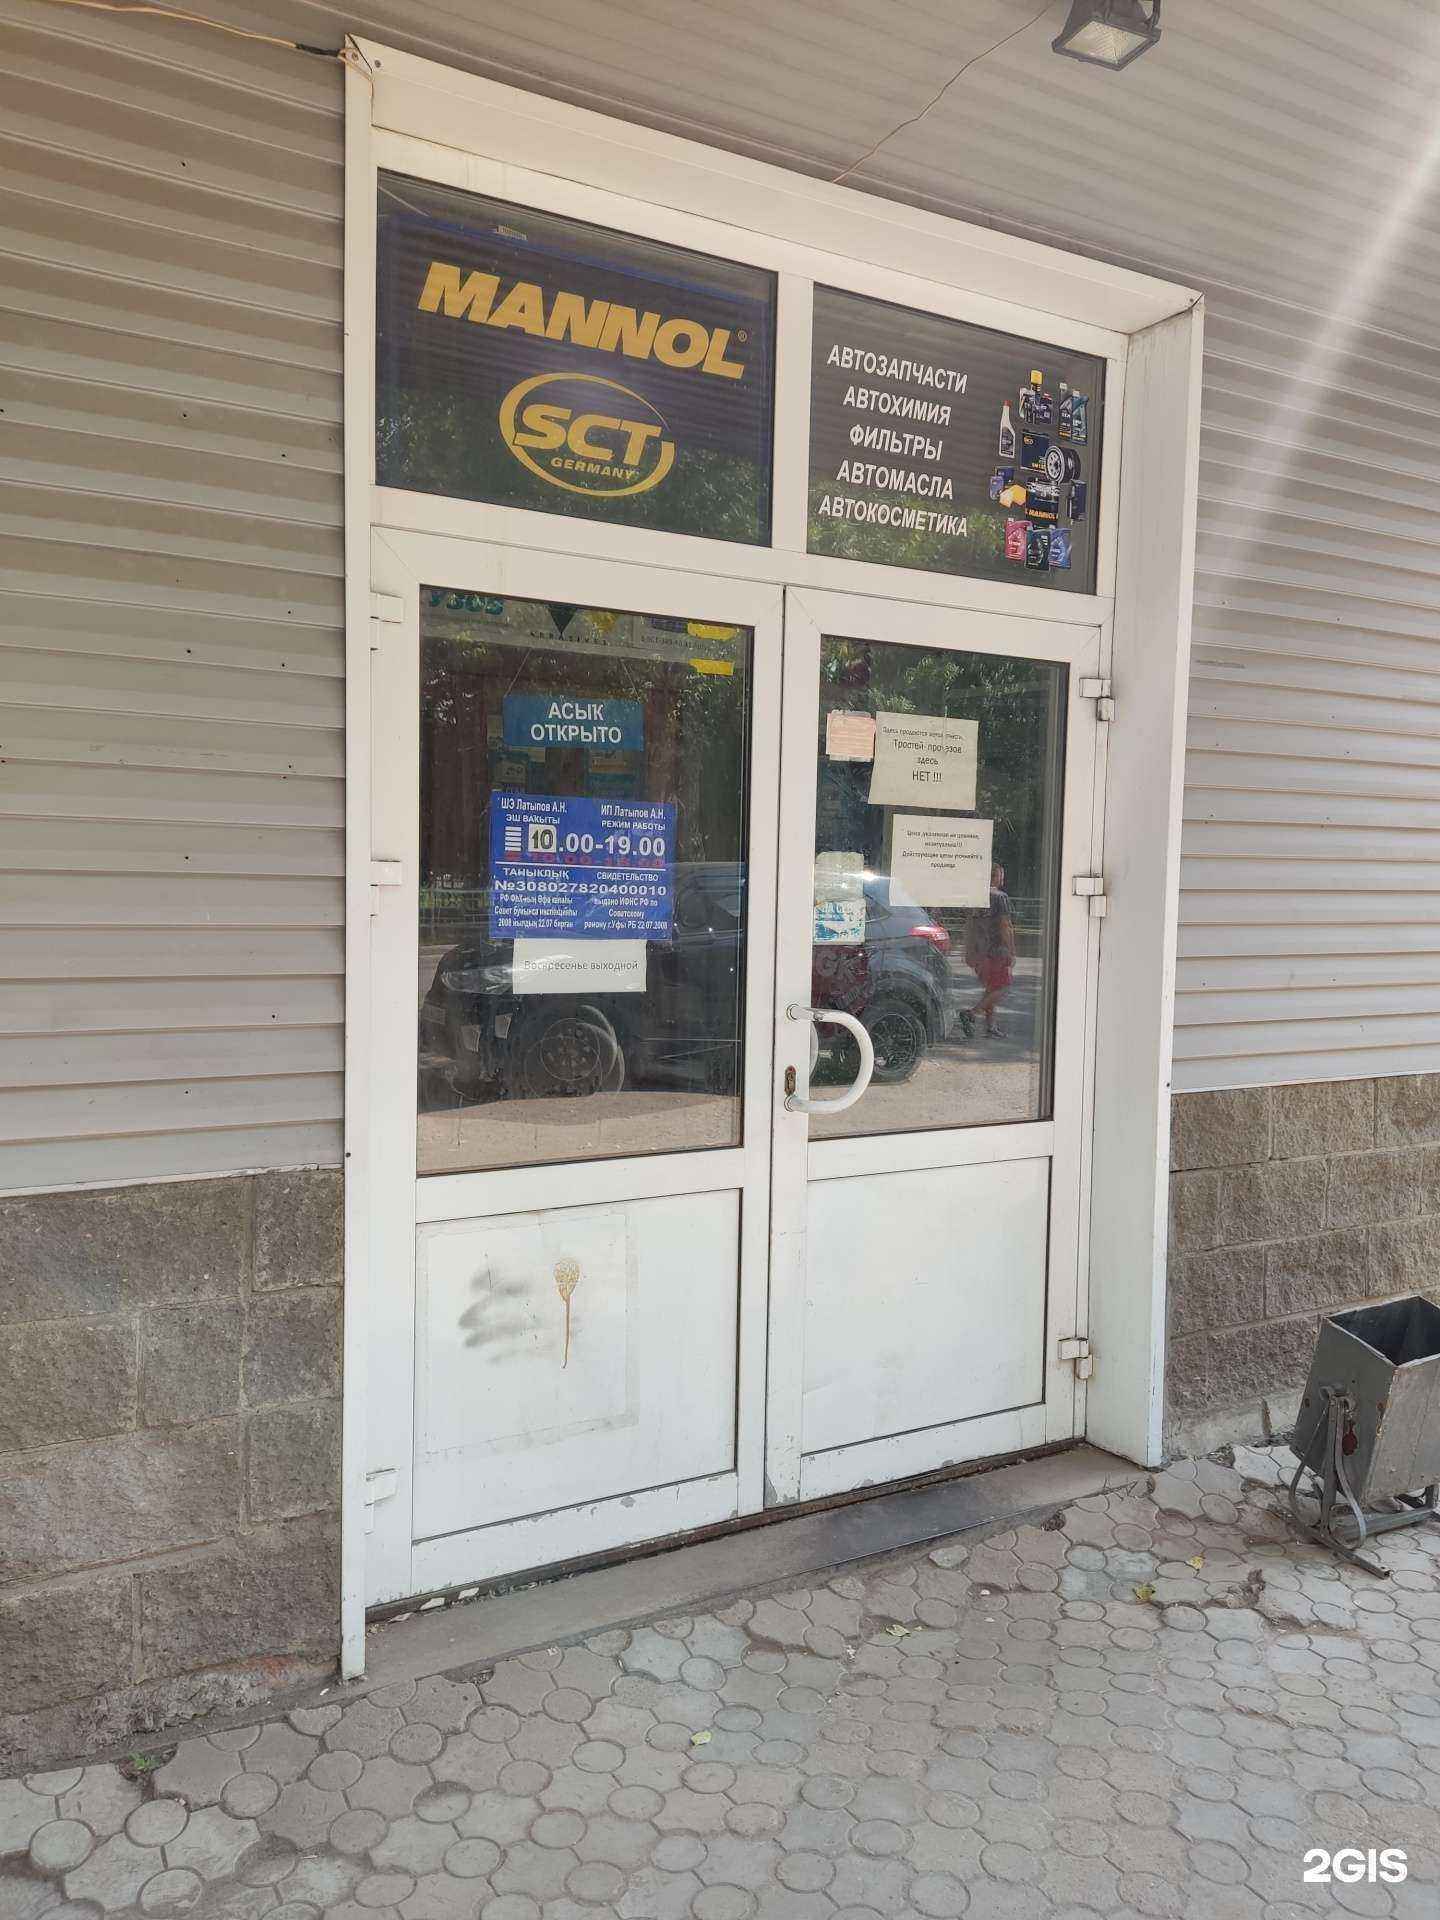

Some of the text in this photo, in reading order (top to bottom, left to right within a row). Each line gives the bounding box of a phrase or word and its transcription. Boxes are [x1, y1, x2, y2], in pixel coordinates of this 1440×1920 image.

[418, 261, 744, 380] MANNOL
[827, 344, 968, 394] АВТОЗАПЧАСТИ
[843, 386, 952, 426] АВТОХИМИЯ
[513, 403, 662, 466] SCT
[849, 424, 943, 461] ФИЛЬТРЫ
[550, 456, 636, 481] GERMANY
[836, 459, 954, 500] АВТОМАСЛА
[818, 495, 968, 537] АВТОКОСМЕТИКА
[530, 724, 622, 744] ОТКРЫТО
[912, 770, 931, 782] НЕТ
[516, 799, 551, 813] Латыпов
[552, 801, 568, 814] А.Н.
[601, 805, 666, 820] ИП Латыпов А.Н.
[601, 820, 666, 831] РЕЖИМ РАБОТЫ
[596, 871, 659, 882] СВИДЕТЕЛЬСТВО
[494, 880, 667, 896] №308027820400010
[524, 960, 639, 972] Воскресенье выходной
